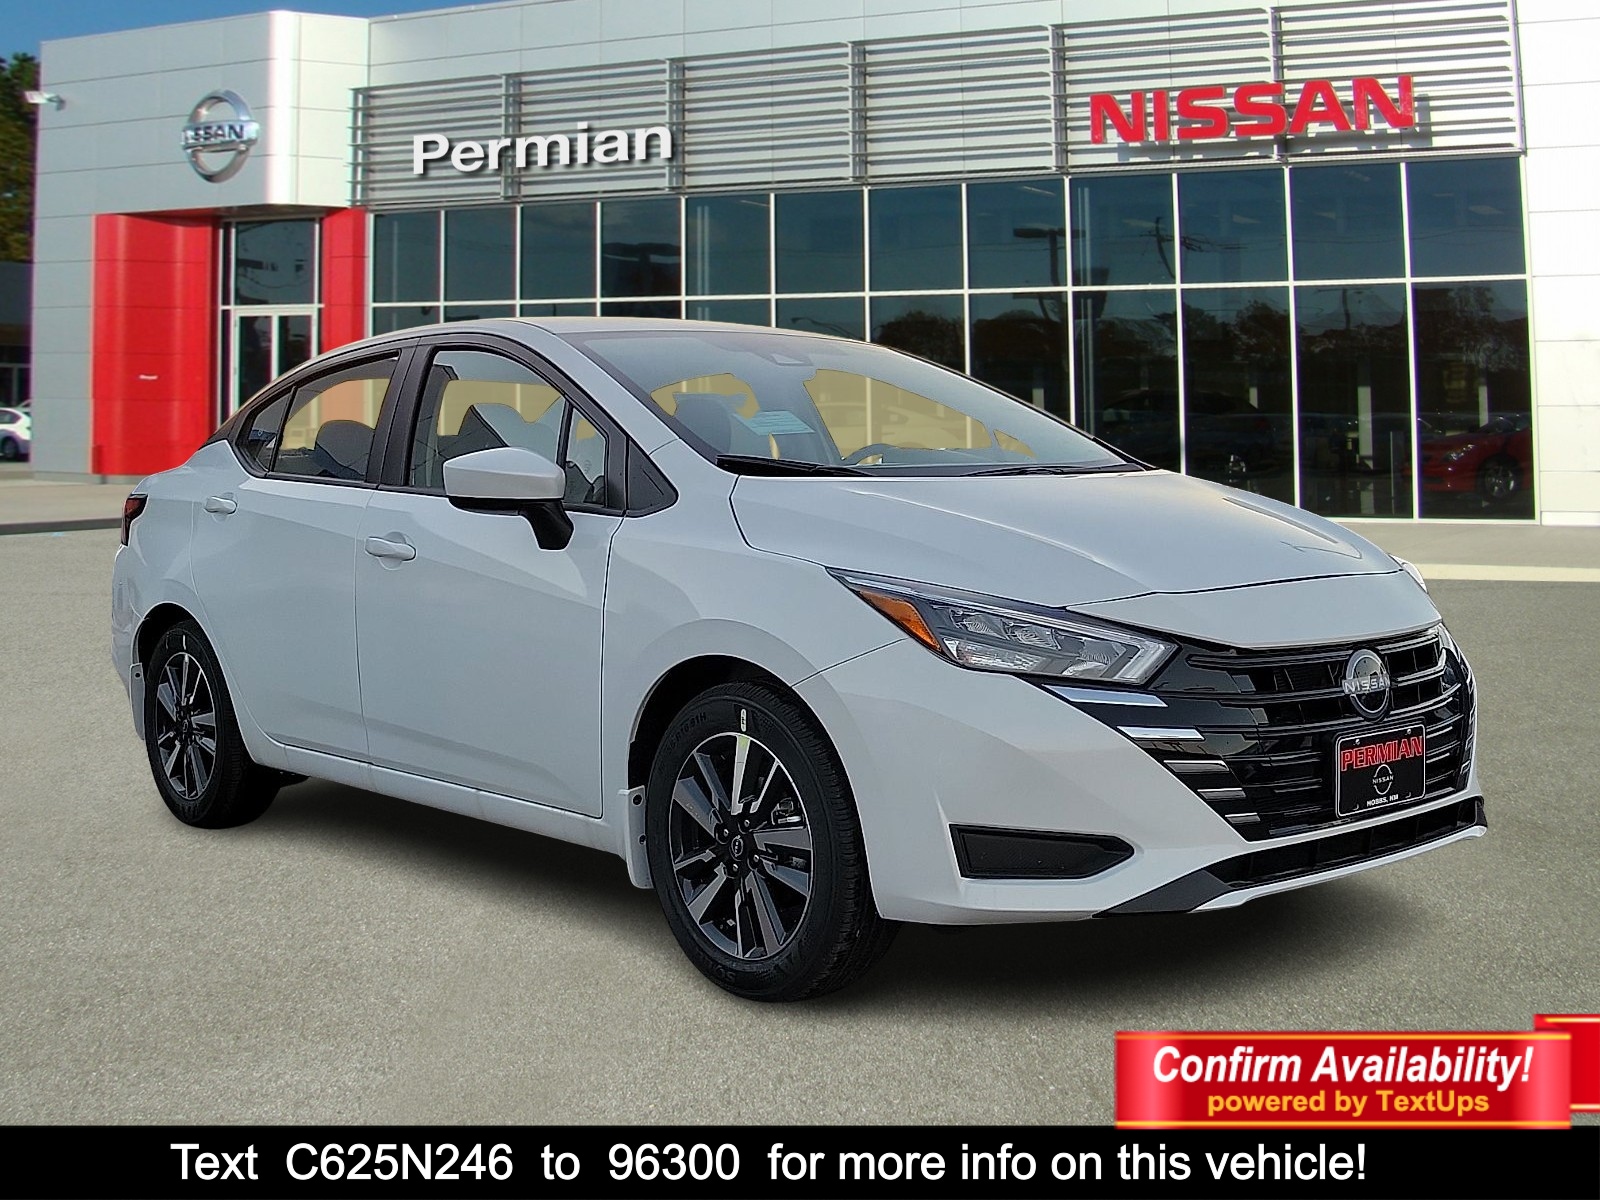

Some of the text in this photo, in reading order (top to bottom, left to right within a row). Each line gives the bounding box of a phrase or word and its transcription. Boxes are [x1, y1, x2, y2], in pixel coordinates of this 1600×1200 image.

[1090, 74, 1415, 145] NISSAN
[413, 122, 672, 175] Permian
[1344, 676, 1390, 692] NISSAN
[1341, 735, 1423, 772] PERMIAN
[1372, 775, 1394, 784] NISSAN
